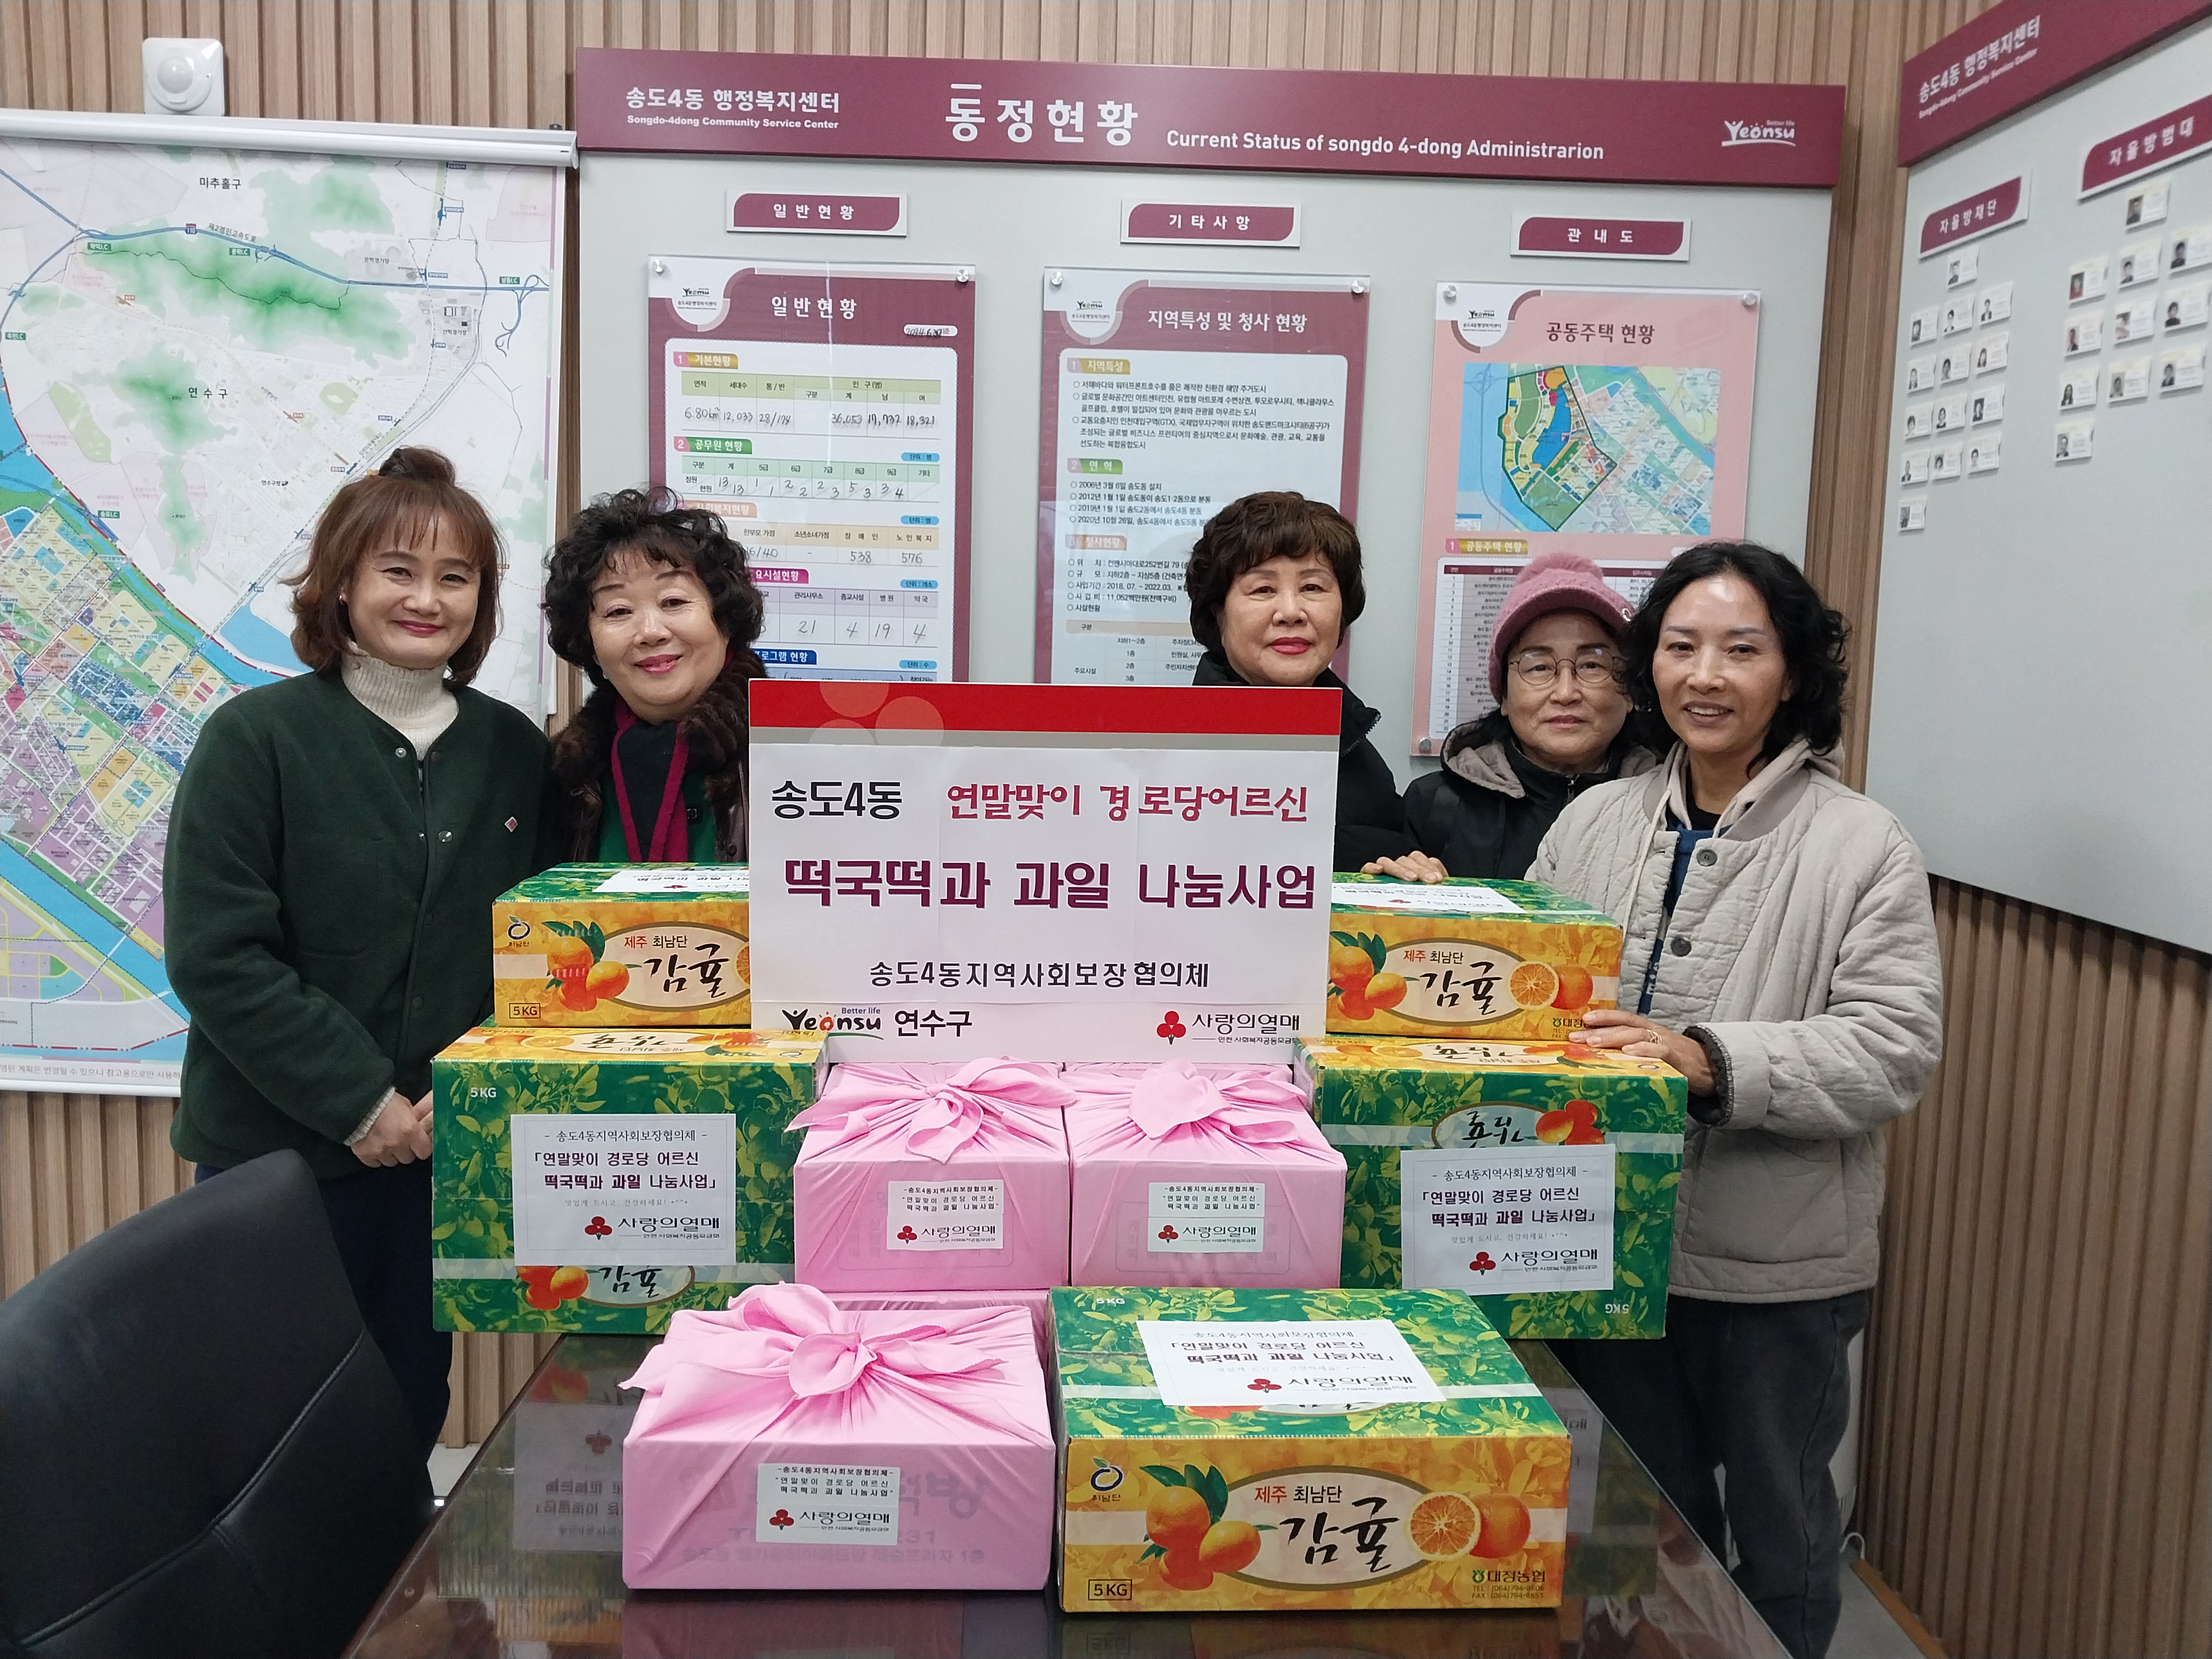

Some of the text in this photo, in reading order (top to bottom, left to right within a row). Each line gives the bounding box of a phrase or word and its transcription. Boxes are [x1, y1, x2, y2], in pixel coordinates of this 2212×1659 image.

[1919, 15, 2040, 103] 송도4동 행정복지센터
[627, 87, 840, 113] 송도4동 행정복지센터
[627, 115, 839, 130] Songdo-4dong Community Service Center
[1724, 120, 1795, 141] Yeonsu
[1167, 130, 1604, 161] Current Status of songdo 4-dong Administrarion
[2109, 116, 2194, 167] 자율방범대
[200, 177, 241, 190] 미추홀구
[773, 203, 854, 221] 일반현황
[1939, 199, 1997, 234] 자율방재단
[1168, 213, 1251, 231] 기타사항
[1566, 227, 1635, 245] 관내도
[771, 297, 857, 320] 일반현황
[1148, 310, 1308, 333] 지역특성 및 청사 현황
[1546, 321, 1655, 345] 공동주택 현황
[678, 355, 730, 366] 1 기본현황
[1071, 361, 1077, 370] 1
[188, 387, 228, 399] 연수구
[678, 439, 743, 452] 2 공무원 현황
[719, 477, 729, 487] 13
[895, 488, 904, 499] 4
[1103, 493, 1113, 501] 1월
[1450, 542, 1454, 550] 1
[1467, 541, 1501, 552] 공동주택
[850, 551, 923, 564] 538 576
[798, 619, 816, 635] 21
[846, 622, 858, 638] 4
[875, 623, 891, 639] 19
[790, 652, 808, 663] 현황
[770, 780, 903, 820] 송도4동
[947, 783, 1081, 821] 연말맞이
[784, 859, 991, 909] 떡국떡과
[1013, 861, 1110, 909] 과일
[1138, 864, 1315, 910] 나눔사업
[624, 935, 687, 949] 제주 최남단
[1403, 950, 1464, 965] 제주 최남단
[642, 943, 730, 999] 감귤
[869, 961, 1209, 989] 송도4동지역사회보장협의체
[1419, 961, 1503, 1014] 감귤
[782, 1008, 972, 1037] Yeonsu 연수구
[1192, 1014, 1300, 1034] 사랑의열매
[556, 1130, 696, 1142] 송도4동지역사회보장협의체
[607, 1152, 649, 1166] 경로당
[657, 1152, 698, 1166] 어르신
[544, 1174, 603, 1189] 떡국떡과
[612, 1174, 640, 1189] 과일
[1443, 1166, 1576, 1182] 송도4동지역사회보장협의체
[1492, 1189, 1532, 1204] 경로당
[1540, 1187, 1579, 1201] 어르신
[618, 1217, 720, 1233] 사랑의열매
[1432, 1213, 1488, 1227] 떡국떡과
[1496, 1210, 1523, 1225] 과일
[921, 1225, 995, 1239] 사랑의열매
[1182, 1226, 1256, 1239] 사랑의열매
[1501, 1249, 1598, 1266] 사랑의열매
[1258, 1341, 1366, 1351] 경로당 어르신
[1186, 1353, 1304, 1364] 떡국떡과 과일
[1288, 1376, 1414, 1388] 사랑의열매
[826, 1478, 888, 1488] 경로당 어르신
[1255, 1486, 1342, 1504] 제주 최남단
[799, 1512, 890, 1526] 사랑의열매
[1279, 1496, 1400, 1572] 감귤
[1488, 1570, 1545, 1583] 대정농협
